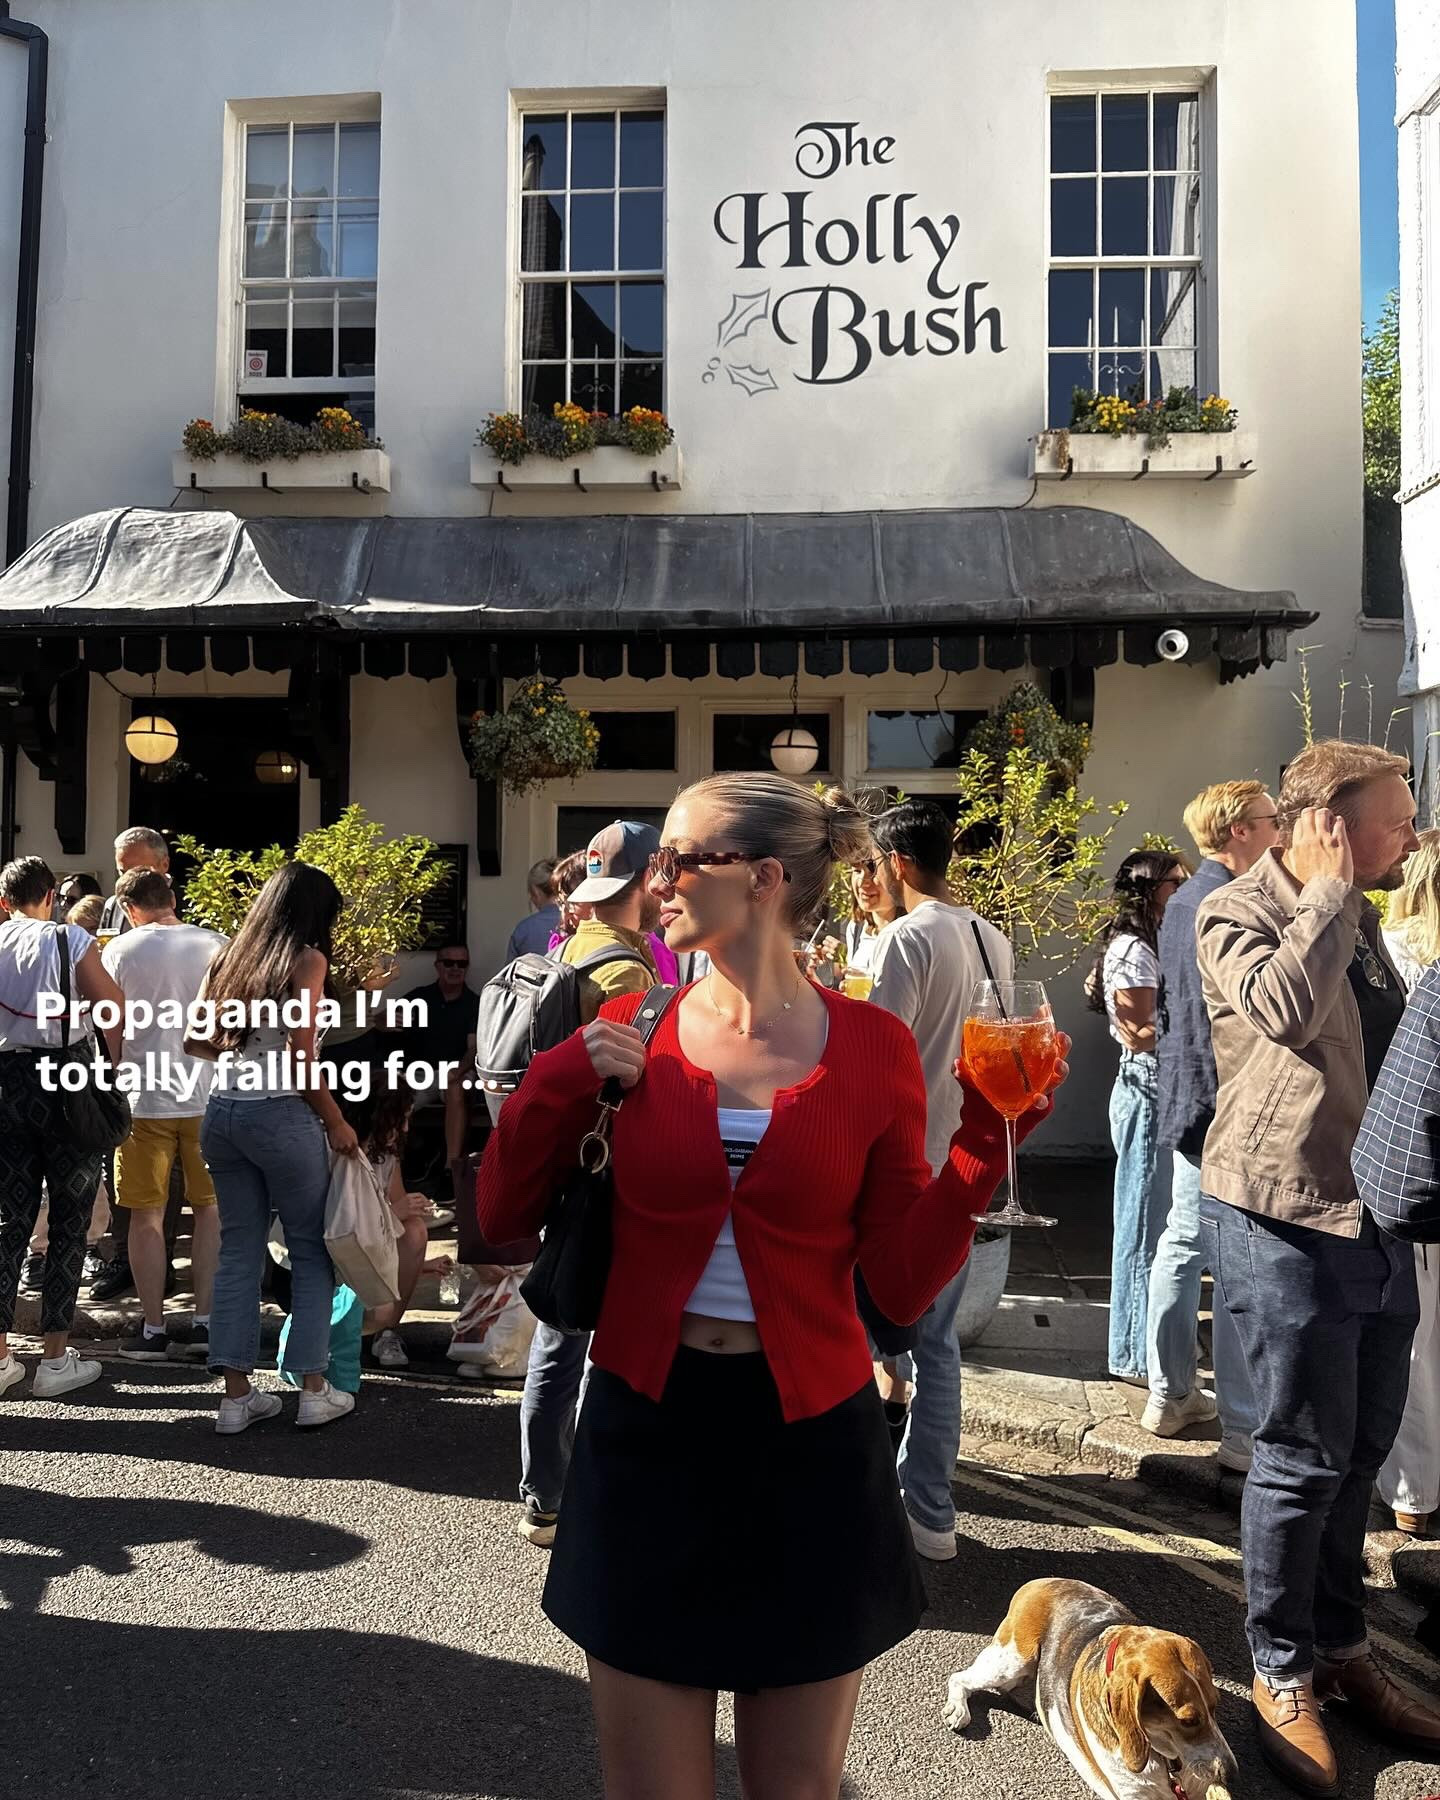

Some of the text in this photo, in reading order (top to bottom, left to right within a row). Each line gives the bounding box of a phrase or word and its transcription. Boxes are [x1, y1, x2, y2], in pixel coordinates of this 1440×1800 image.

[795, 121, 896, 179] The
[714, 191, 961, 300] Holly
[772, 282, 1008, 385] Bush
